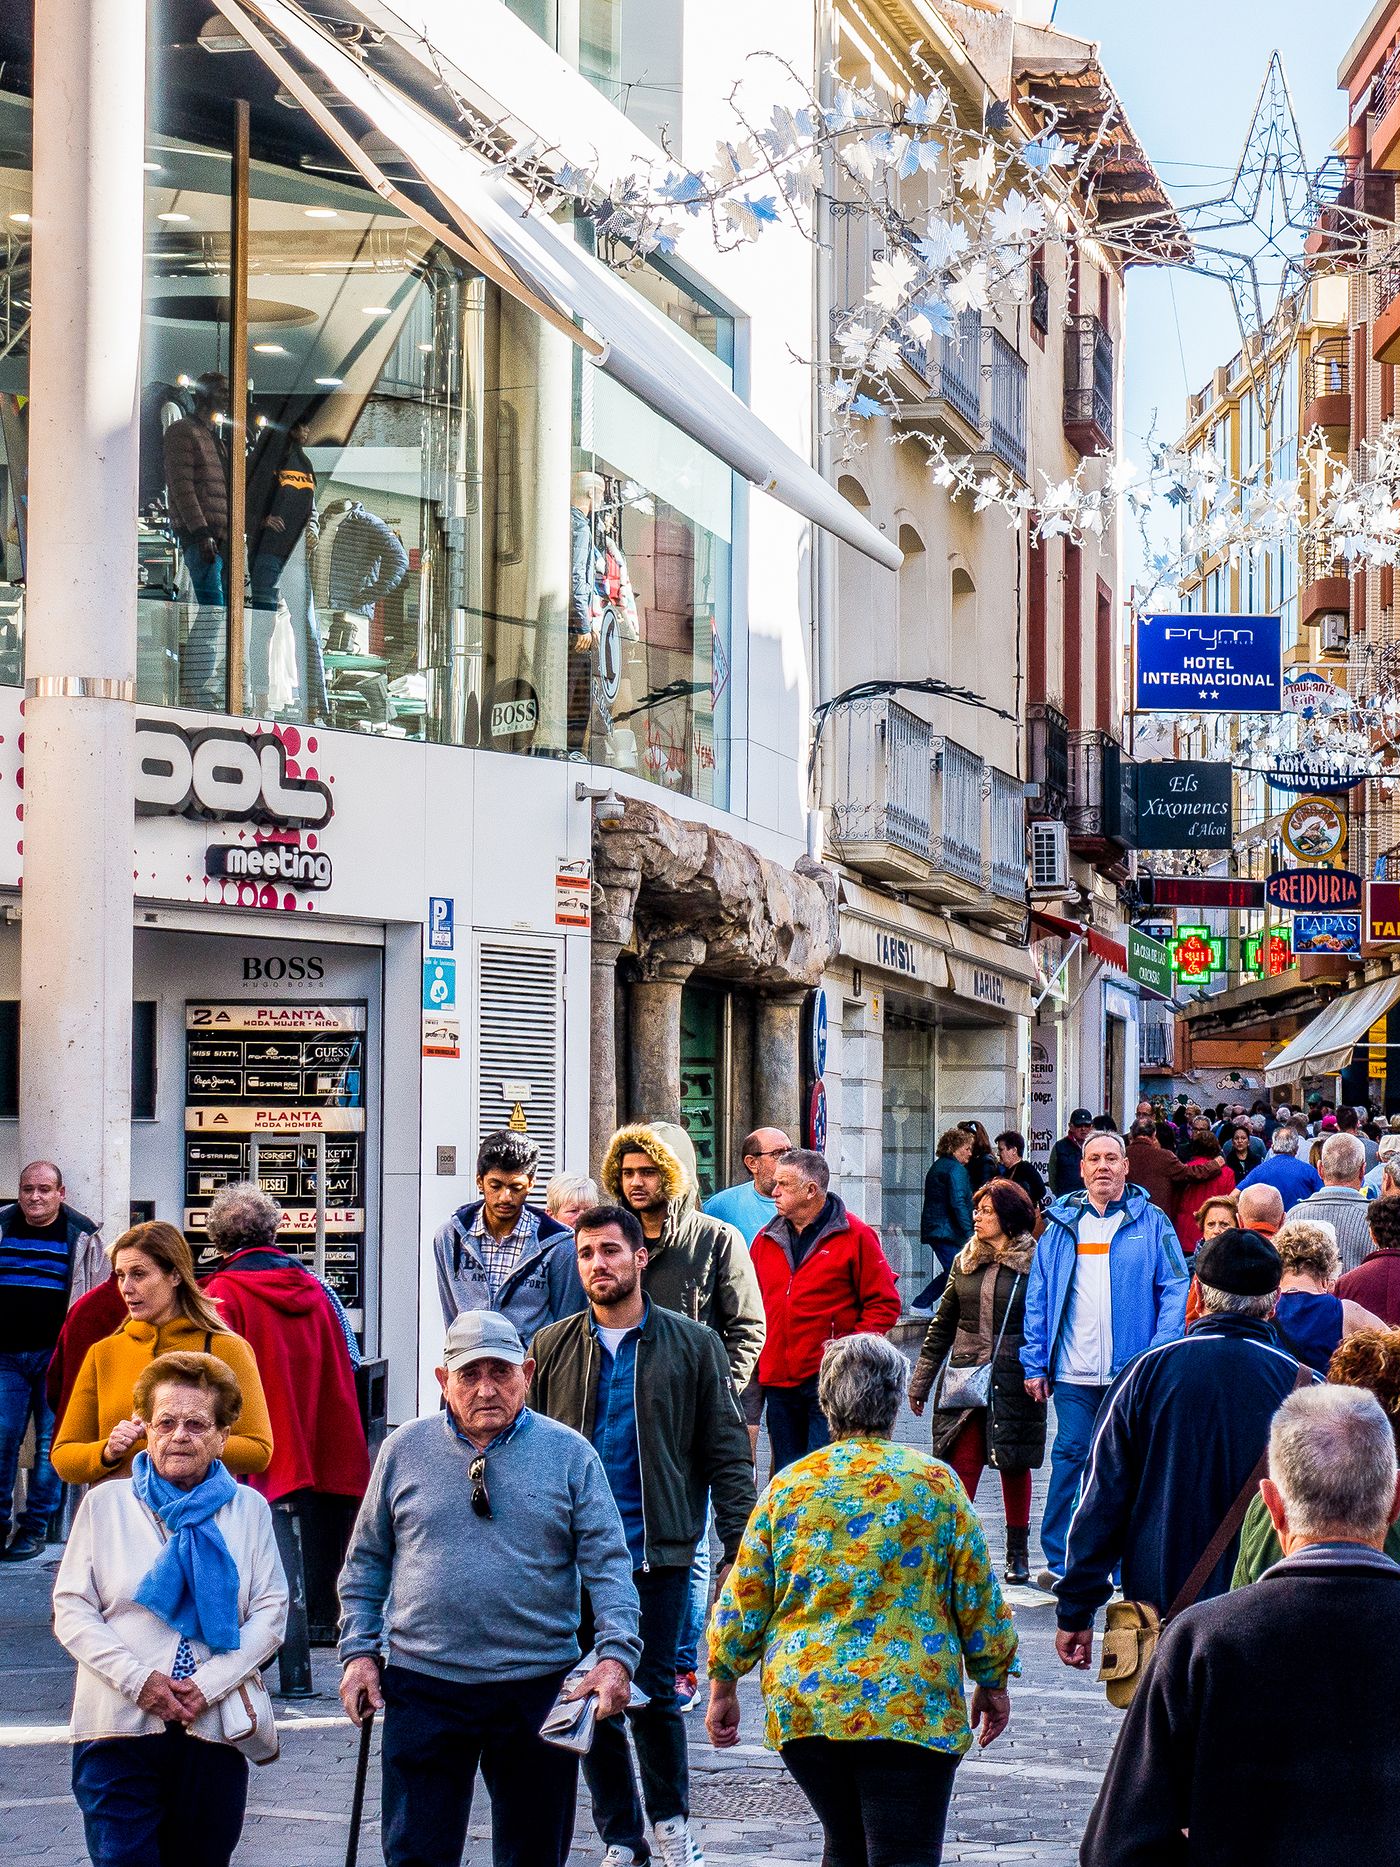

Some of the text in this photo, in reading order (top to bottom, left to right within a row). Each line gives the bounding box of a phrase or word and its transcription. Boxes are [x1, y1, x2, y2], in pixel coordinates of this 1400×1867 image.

[1183, 656, 1235, 670] HOTEL
[1143, 671, 1275, 687] INTERNACIONAL
[492, 702, 535, 726] BOSS
[134, 719, 334, 830] OOL
[1169, 774, 1199, 792] Els
[1141, 798, 1229, 819] Xixonencs
[1188, 822, 1227, 838] d'Alcoi
[227, 846, 332, 888] meeting
[1269, 873, 1358, 904] FREIDURIA
[1296, 917, 1358, 932] TAPAS
[241, 956, 325, 981] BOSS
[257, 1010, 326, 1020] PLANTA
[315, 1047, 350, 1058] GUESS
[256, 1111, 322, 1121] PLANTA
[307, 1148, 352, 1158] HKETT
[258, 1179, 286, 1191] DIESEL
[307, 1179, 349, 1190] RPLAY
[202, 1247, 217, 1257] NIK
